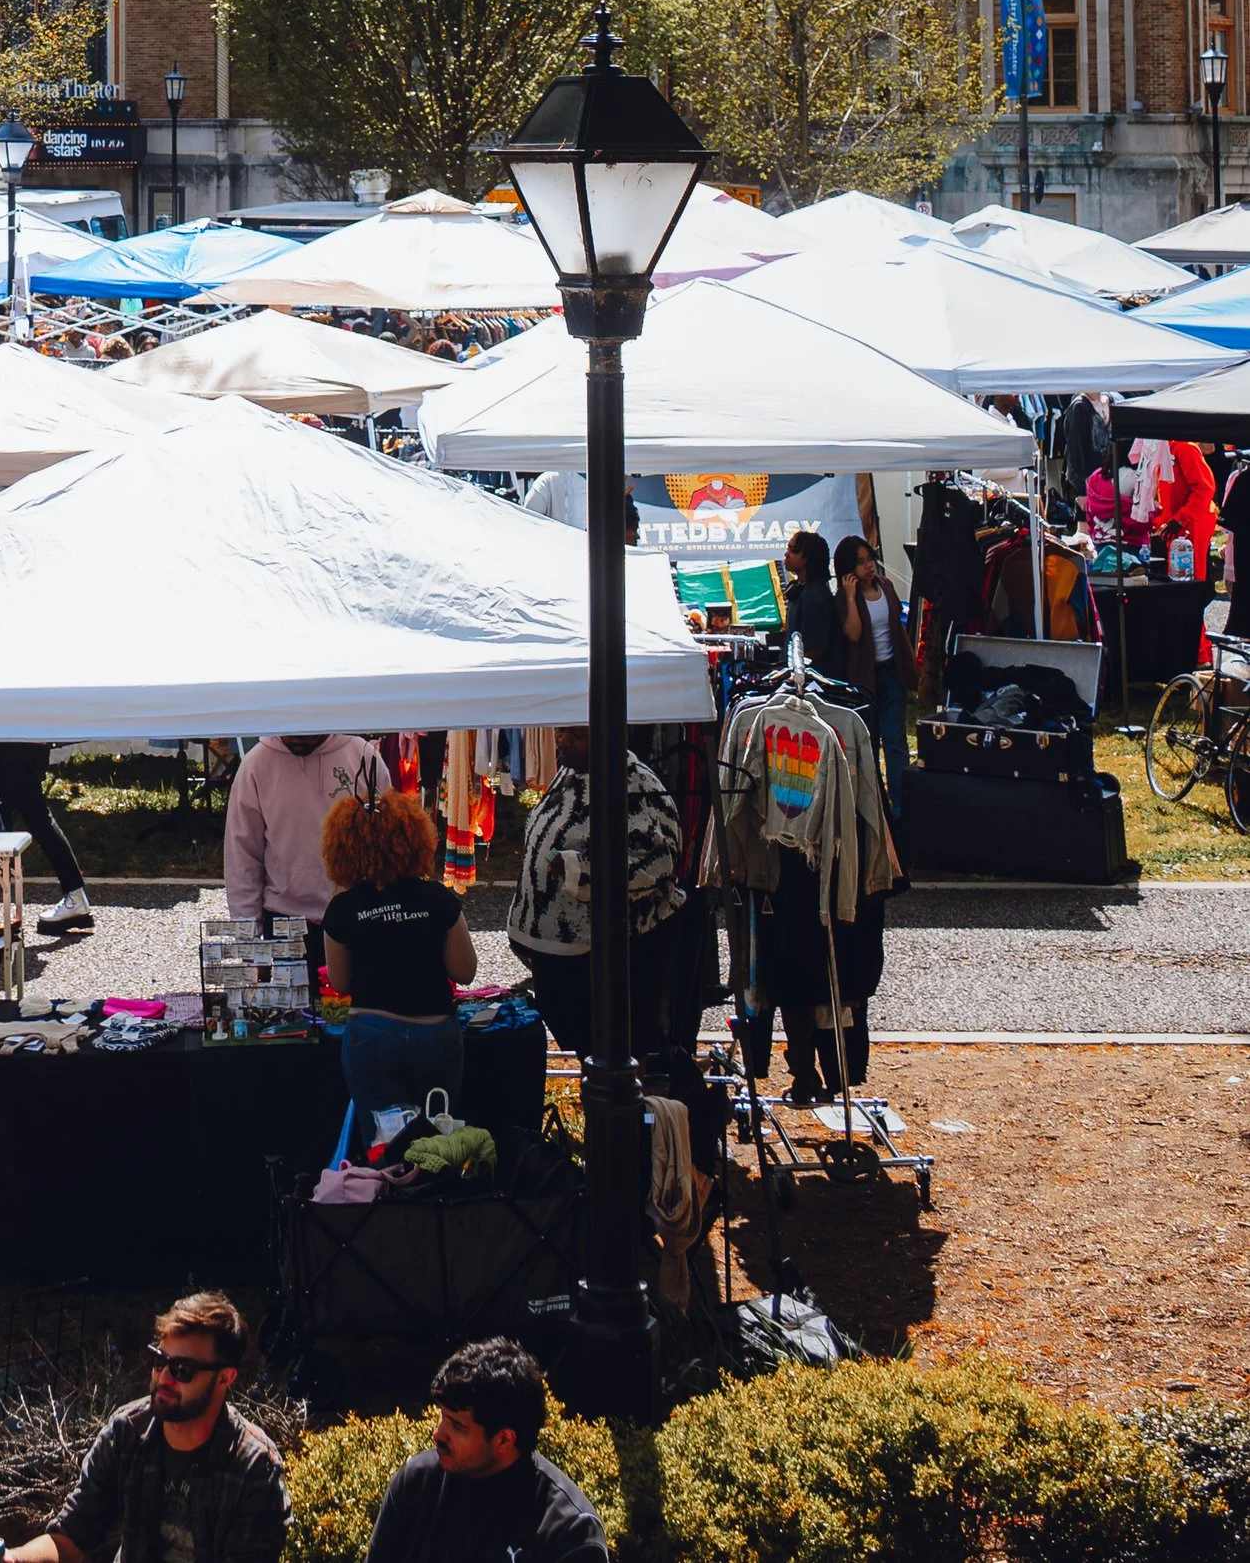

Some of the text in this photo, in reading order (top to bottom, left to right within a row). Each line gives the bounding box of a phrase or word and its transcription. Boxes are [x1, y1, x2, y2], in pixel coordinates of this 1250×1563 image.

[43, 129, 87, 146] dancing
[53, 143, 82, 158] stars
[638, 520, 821, 544] TTEDBYEASY
[357, 903, 402, 921] Measure
[403, 911, 430, 920] Love
